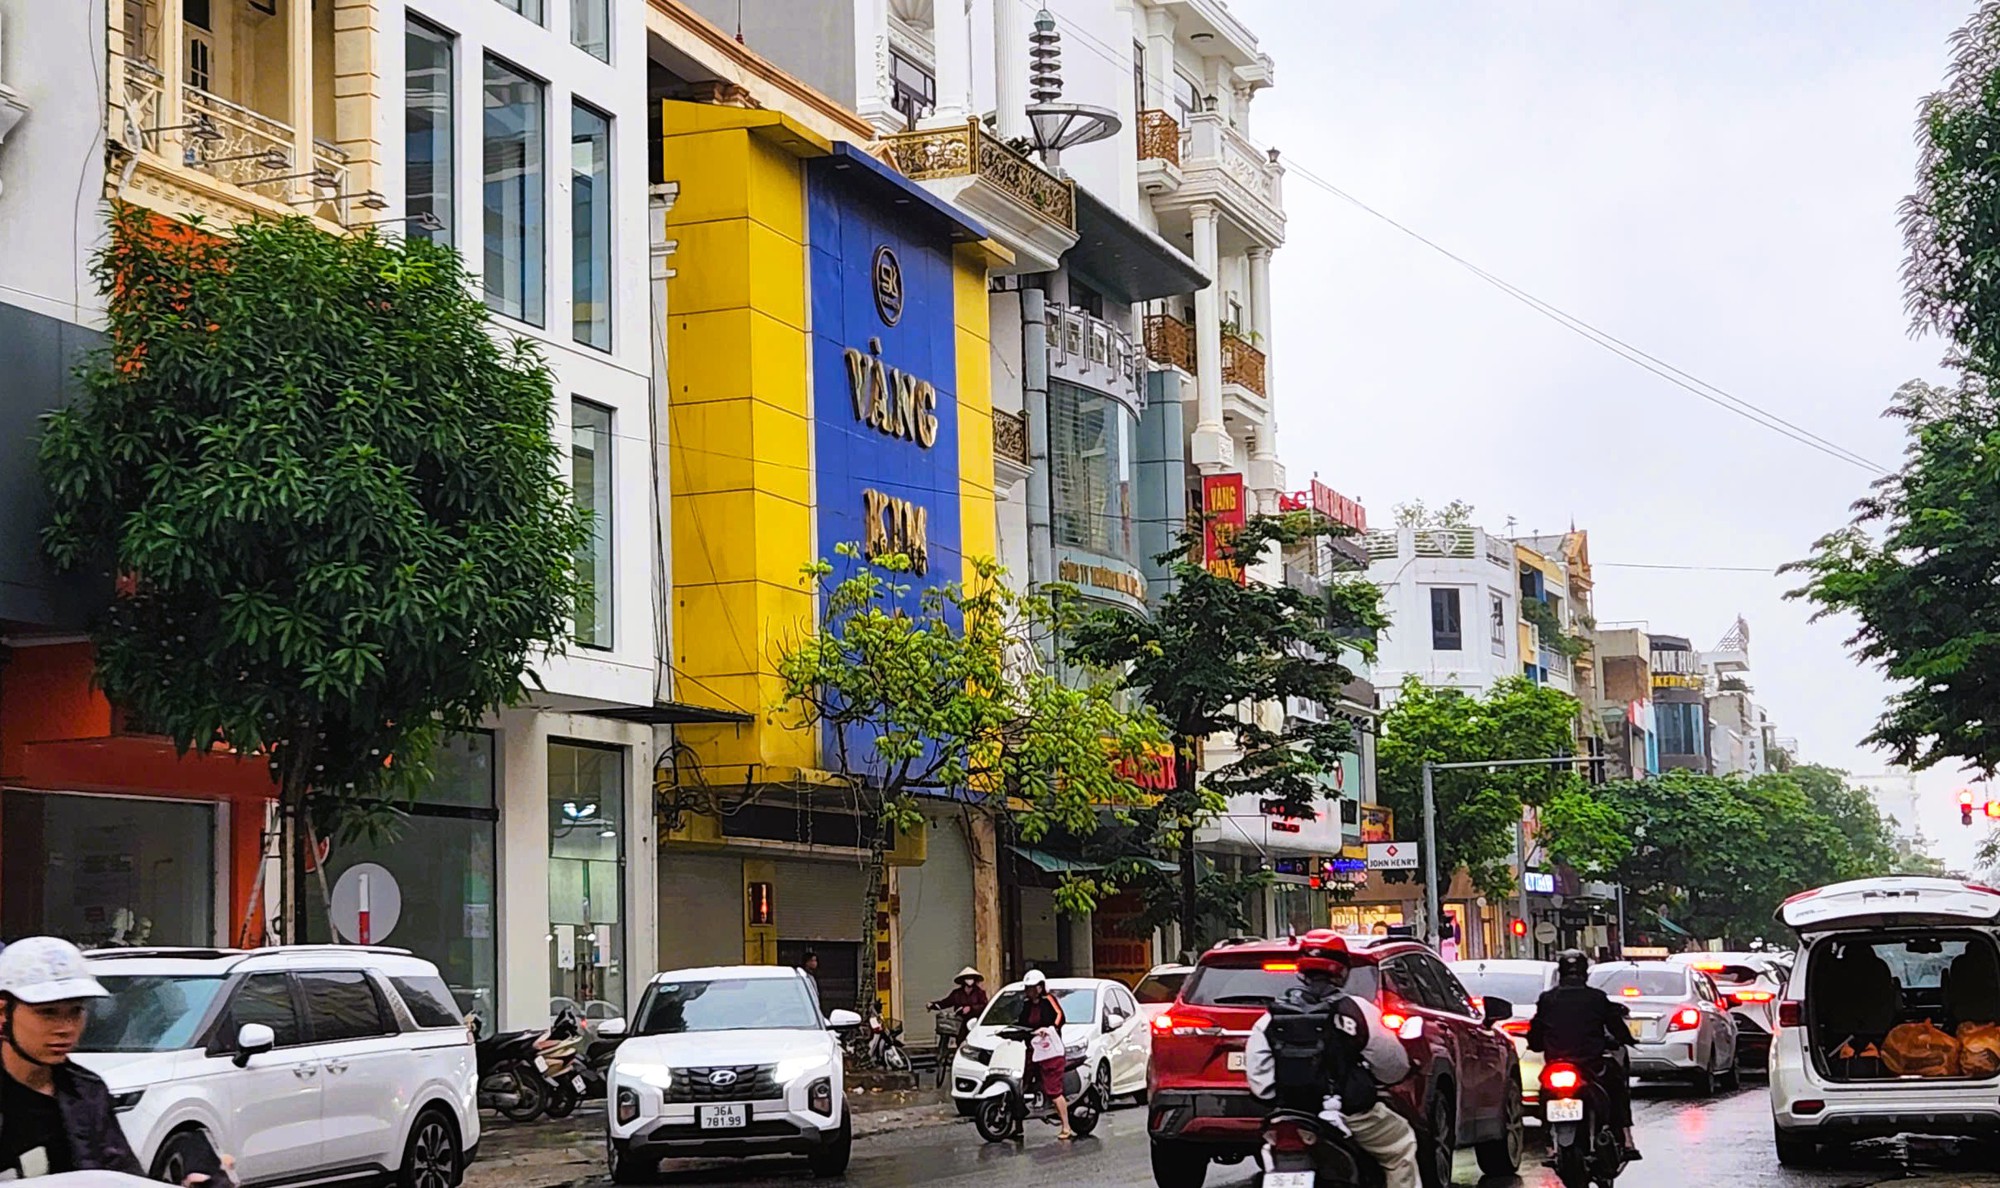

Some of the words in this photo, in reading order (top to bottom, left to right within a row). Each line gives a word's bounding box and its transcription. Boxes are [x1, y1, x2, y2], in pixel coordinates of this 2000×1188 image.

[844, 336, 938, 448] VÀNG
[1210, 482, 1236, 511] VÀNG
[863, 488, 929, 577] KIM
[1370, 859, 1389, 868] JOHN
[1390, 858, 1416, 867] HENRY
[706, 1116, 742, 1127] 781.99
[713, 1106, 733, 1117] 36A
